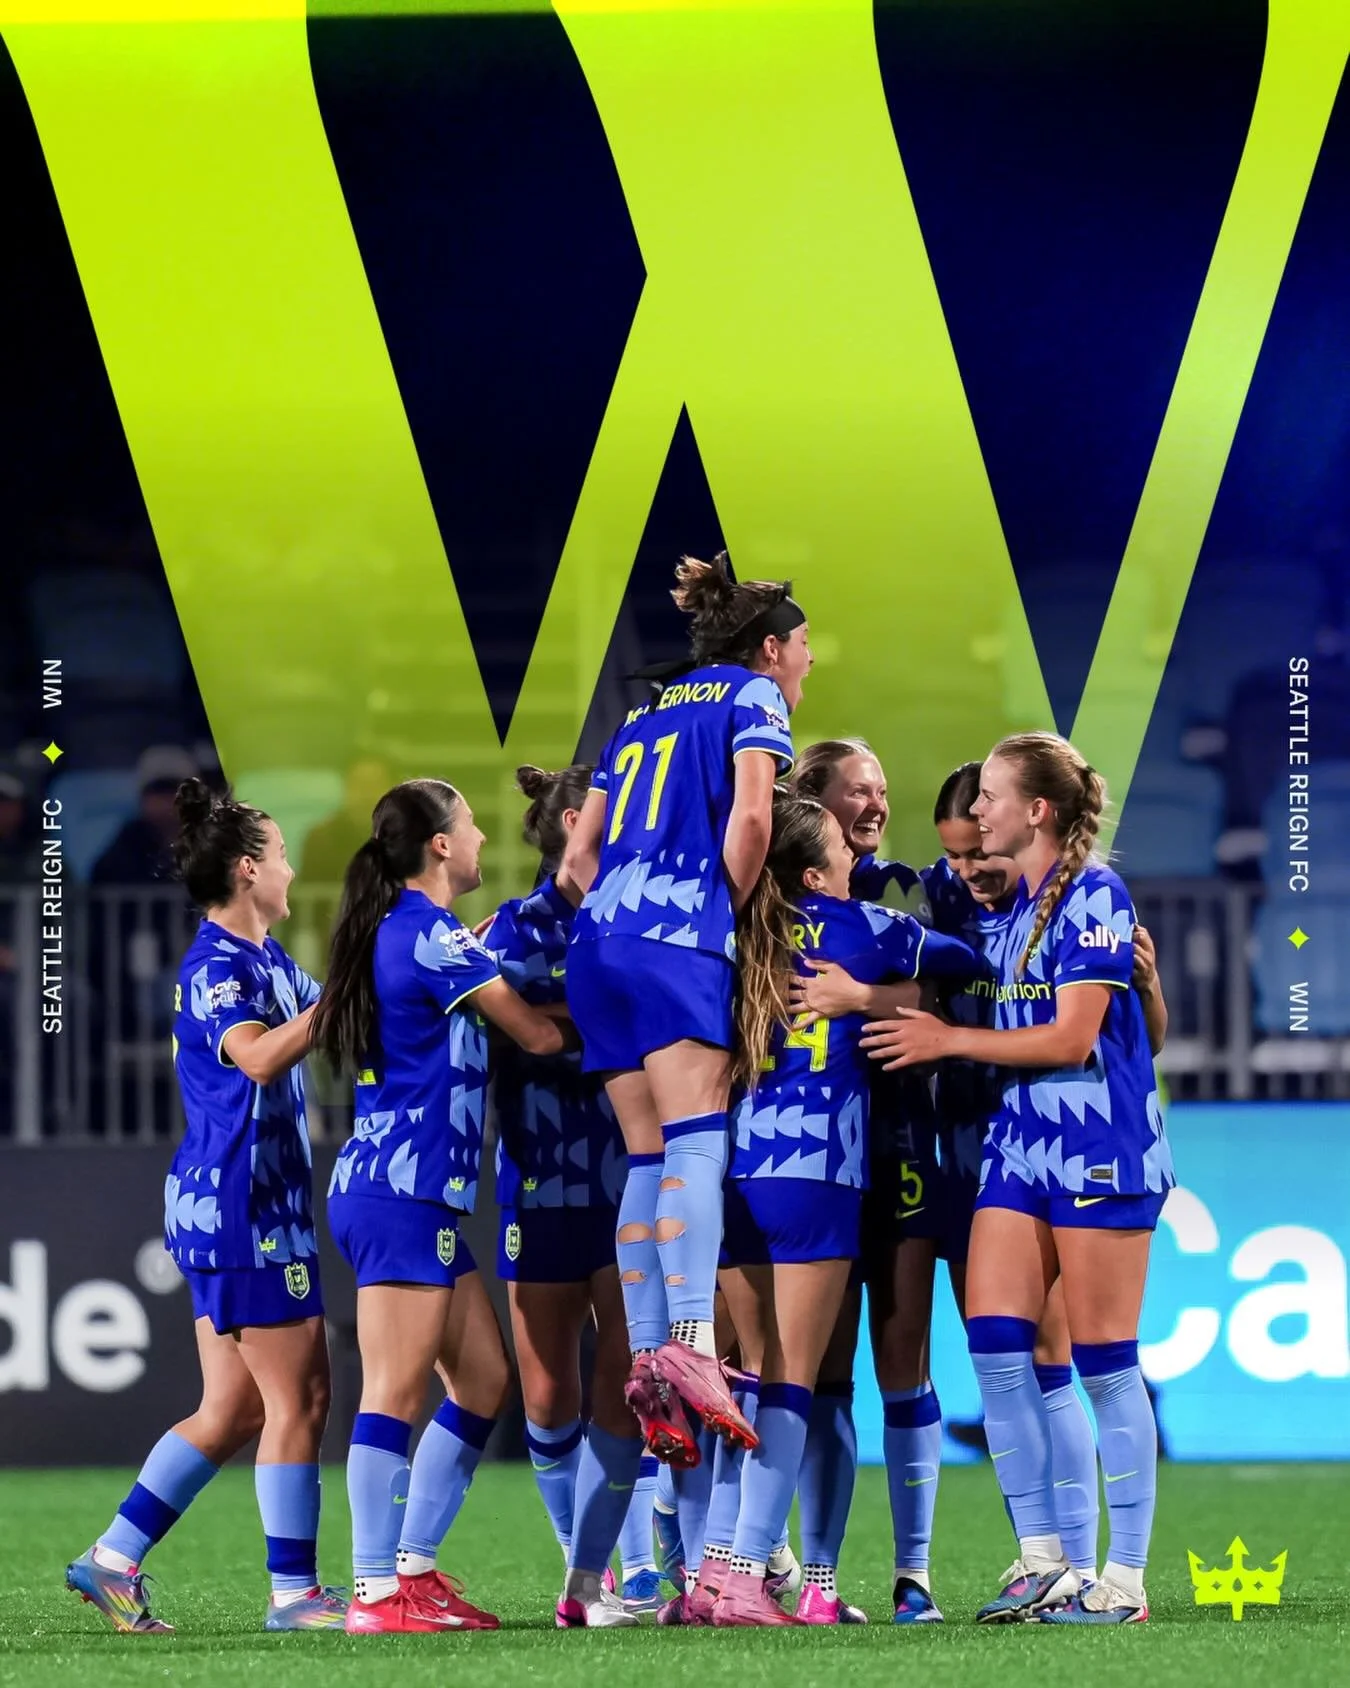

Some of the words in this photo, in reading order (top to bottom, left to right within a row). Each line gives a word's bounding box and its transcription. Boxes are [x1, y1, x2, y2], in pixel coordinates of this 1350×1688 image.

[608, 731, 679, 845] 21
[1078, 925, 1120, 953] ally
[901, 1162, 923, 1206] 5
